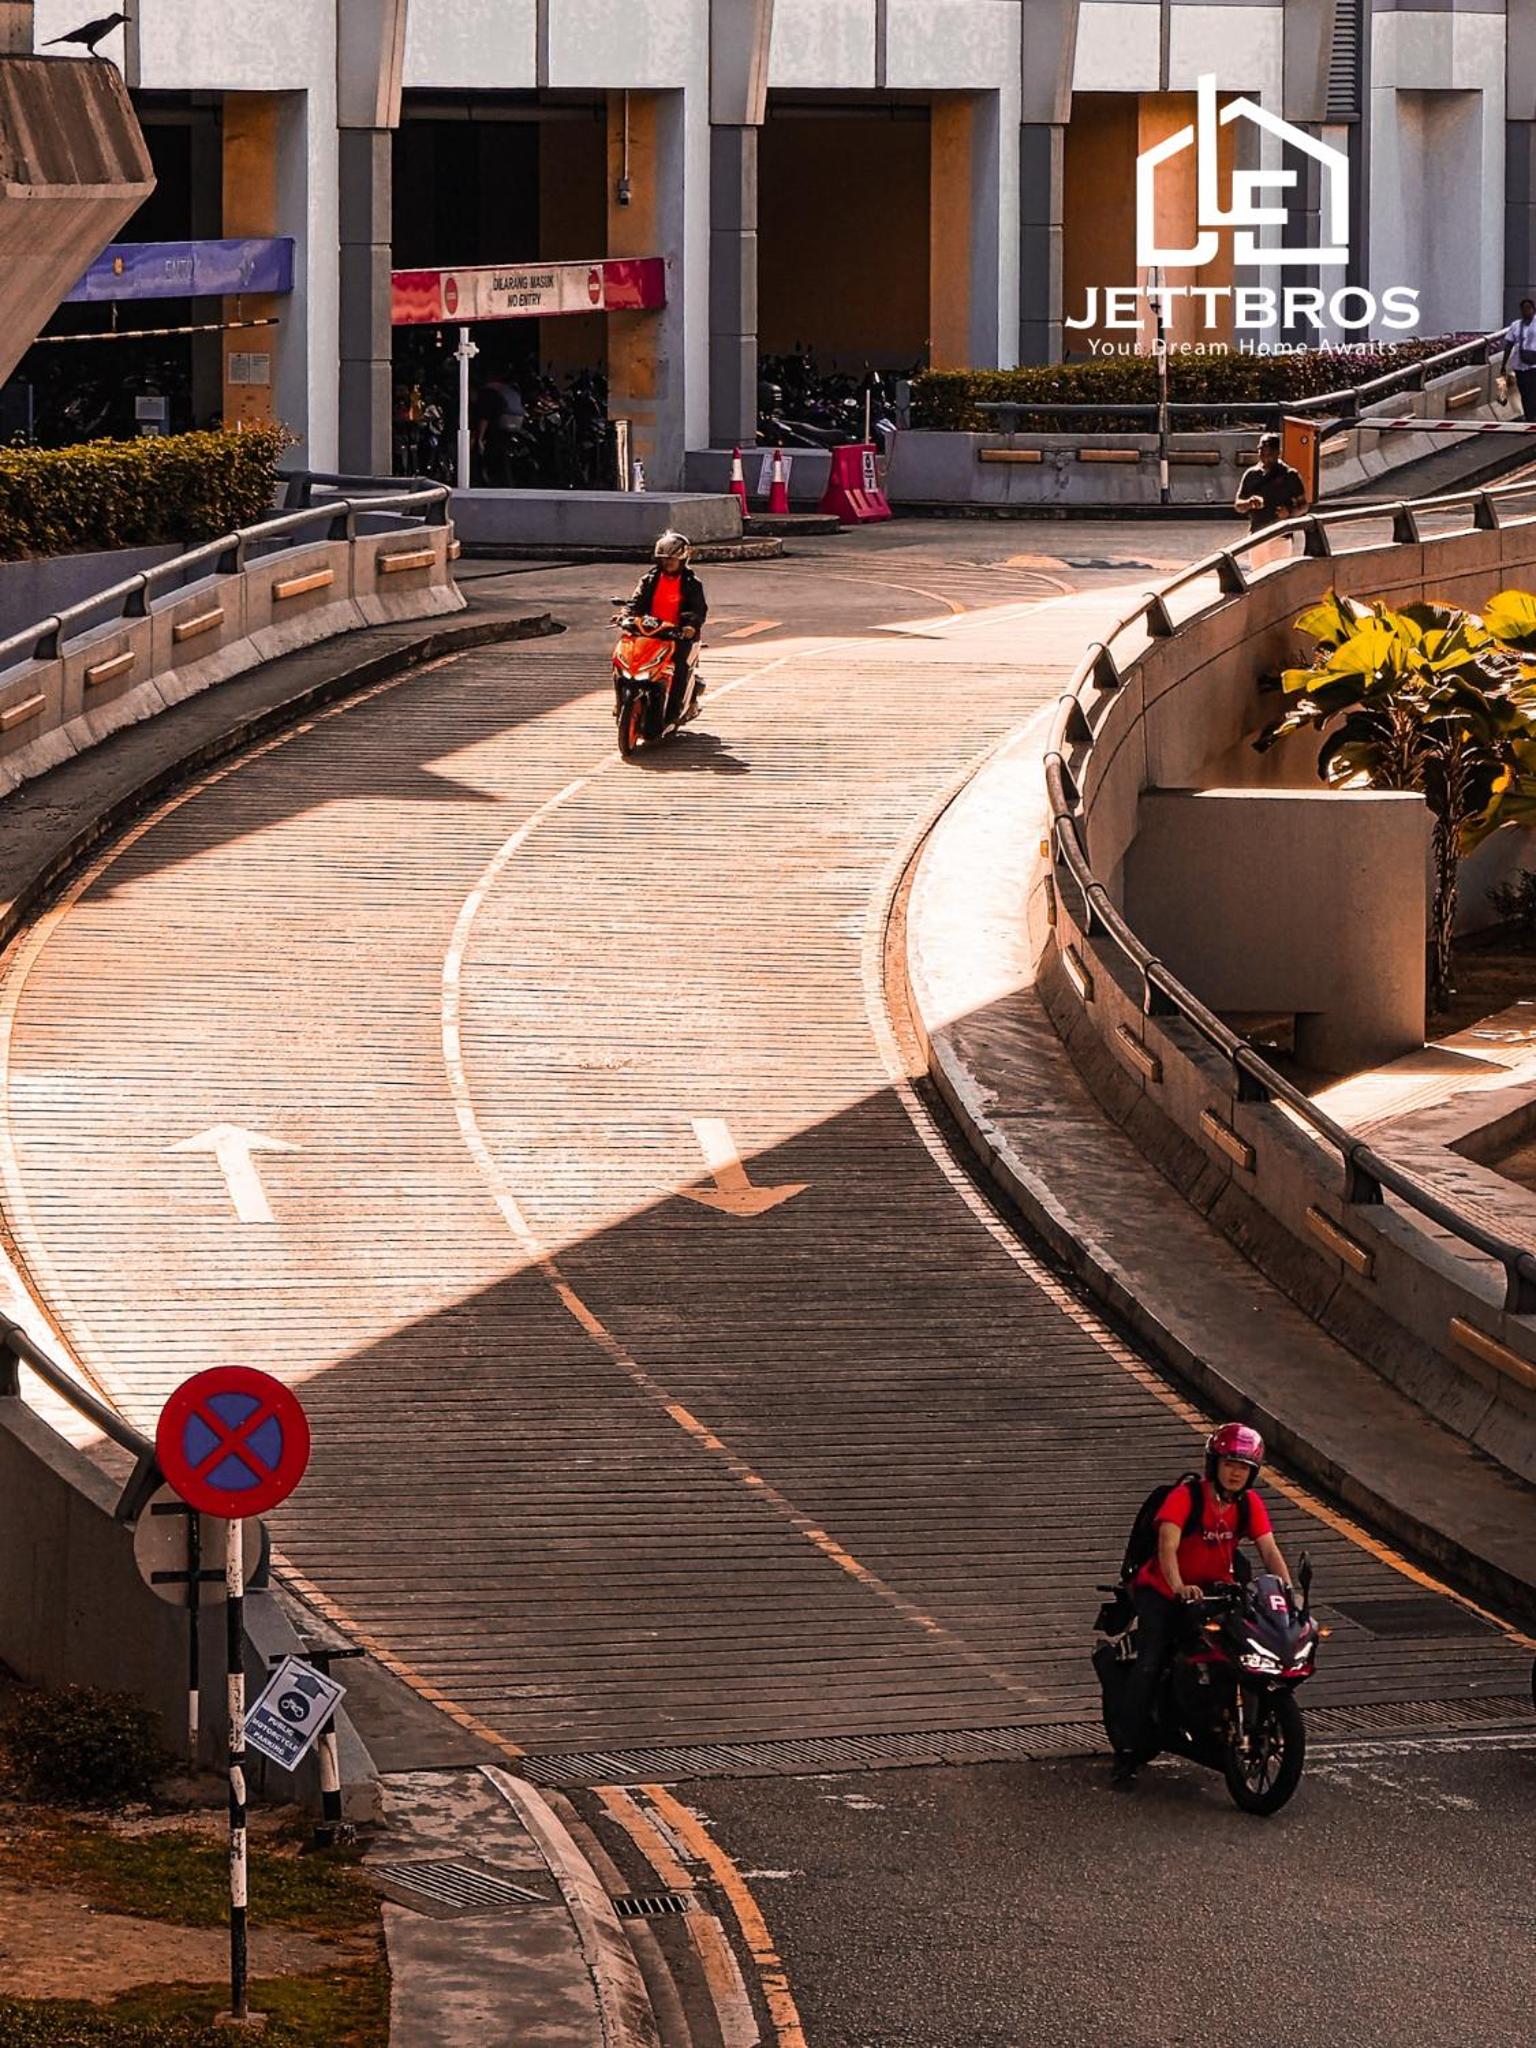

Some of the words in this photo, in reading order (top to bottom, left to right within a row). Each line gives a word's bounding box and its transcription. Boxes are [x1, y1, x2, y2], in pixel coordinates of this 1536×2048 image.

[530, 275, 554, 289] MASUK
[507, 294, 518, 308] NO
[518, 293, 542, 307] ENTRY
[252, 1719, 299, 1752] MOTORCYCLE
[253, 1731, 285, 1756] PARKING
